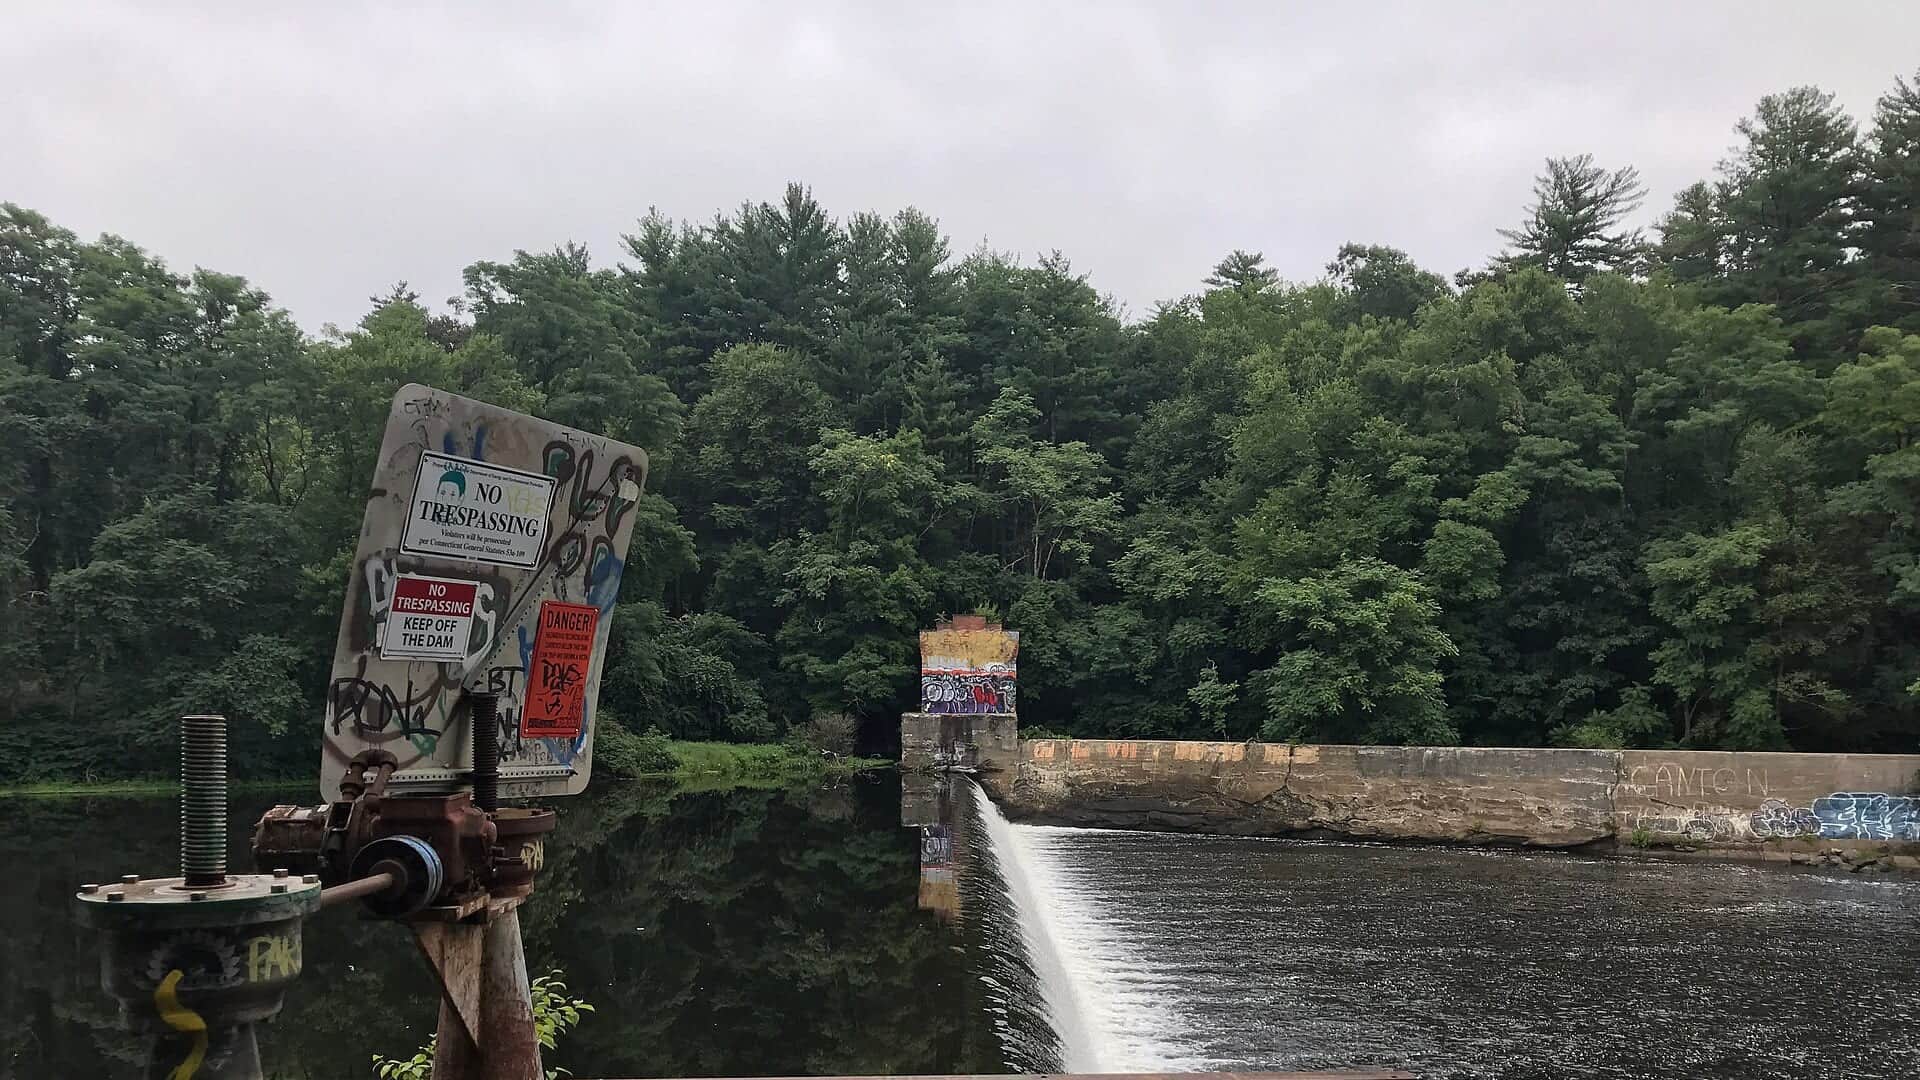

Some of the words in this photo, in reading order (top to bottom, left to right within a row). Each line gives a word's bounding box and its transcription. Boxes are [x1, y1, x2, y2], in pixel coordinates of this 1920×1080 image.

[475, 482, 502, 505] NO
[419, 500, 539, 538] TRESPASSING
[418, 537, 429, 546] per
[430, 538, 463, 550] Connecticut
[464, 543, 485, 553] General
[485, 545, 506, 555] Statutes
[466, 532, 477, 541] will
[476, 533, 484, 542] be
[484, 535, 511, 546] prosecuted
[428, 583, 447, 597] NO
[396, 596, 471, 614] TRESPASSING
[403, 616, 433, 631] KEEP
[435, 619, 458, 633] OFF
[546, 610, 593, 633] DANGER!
[402, 633, 425, 647] THE
[426, 635, 454, 649] DAM
